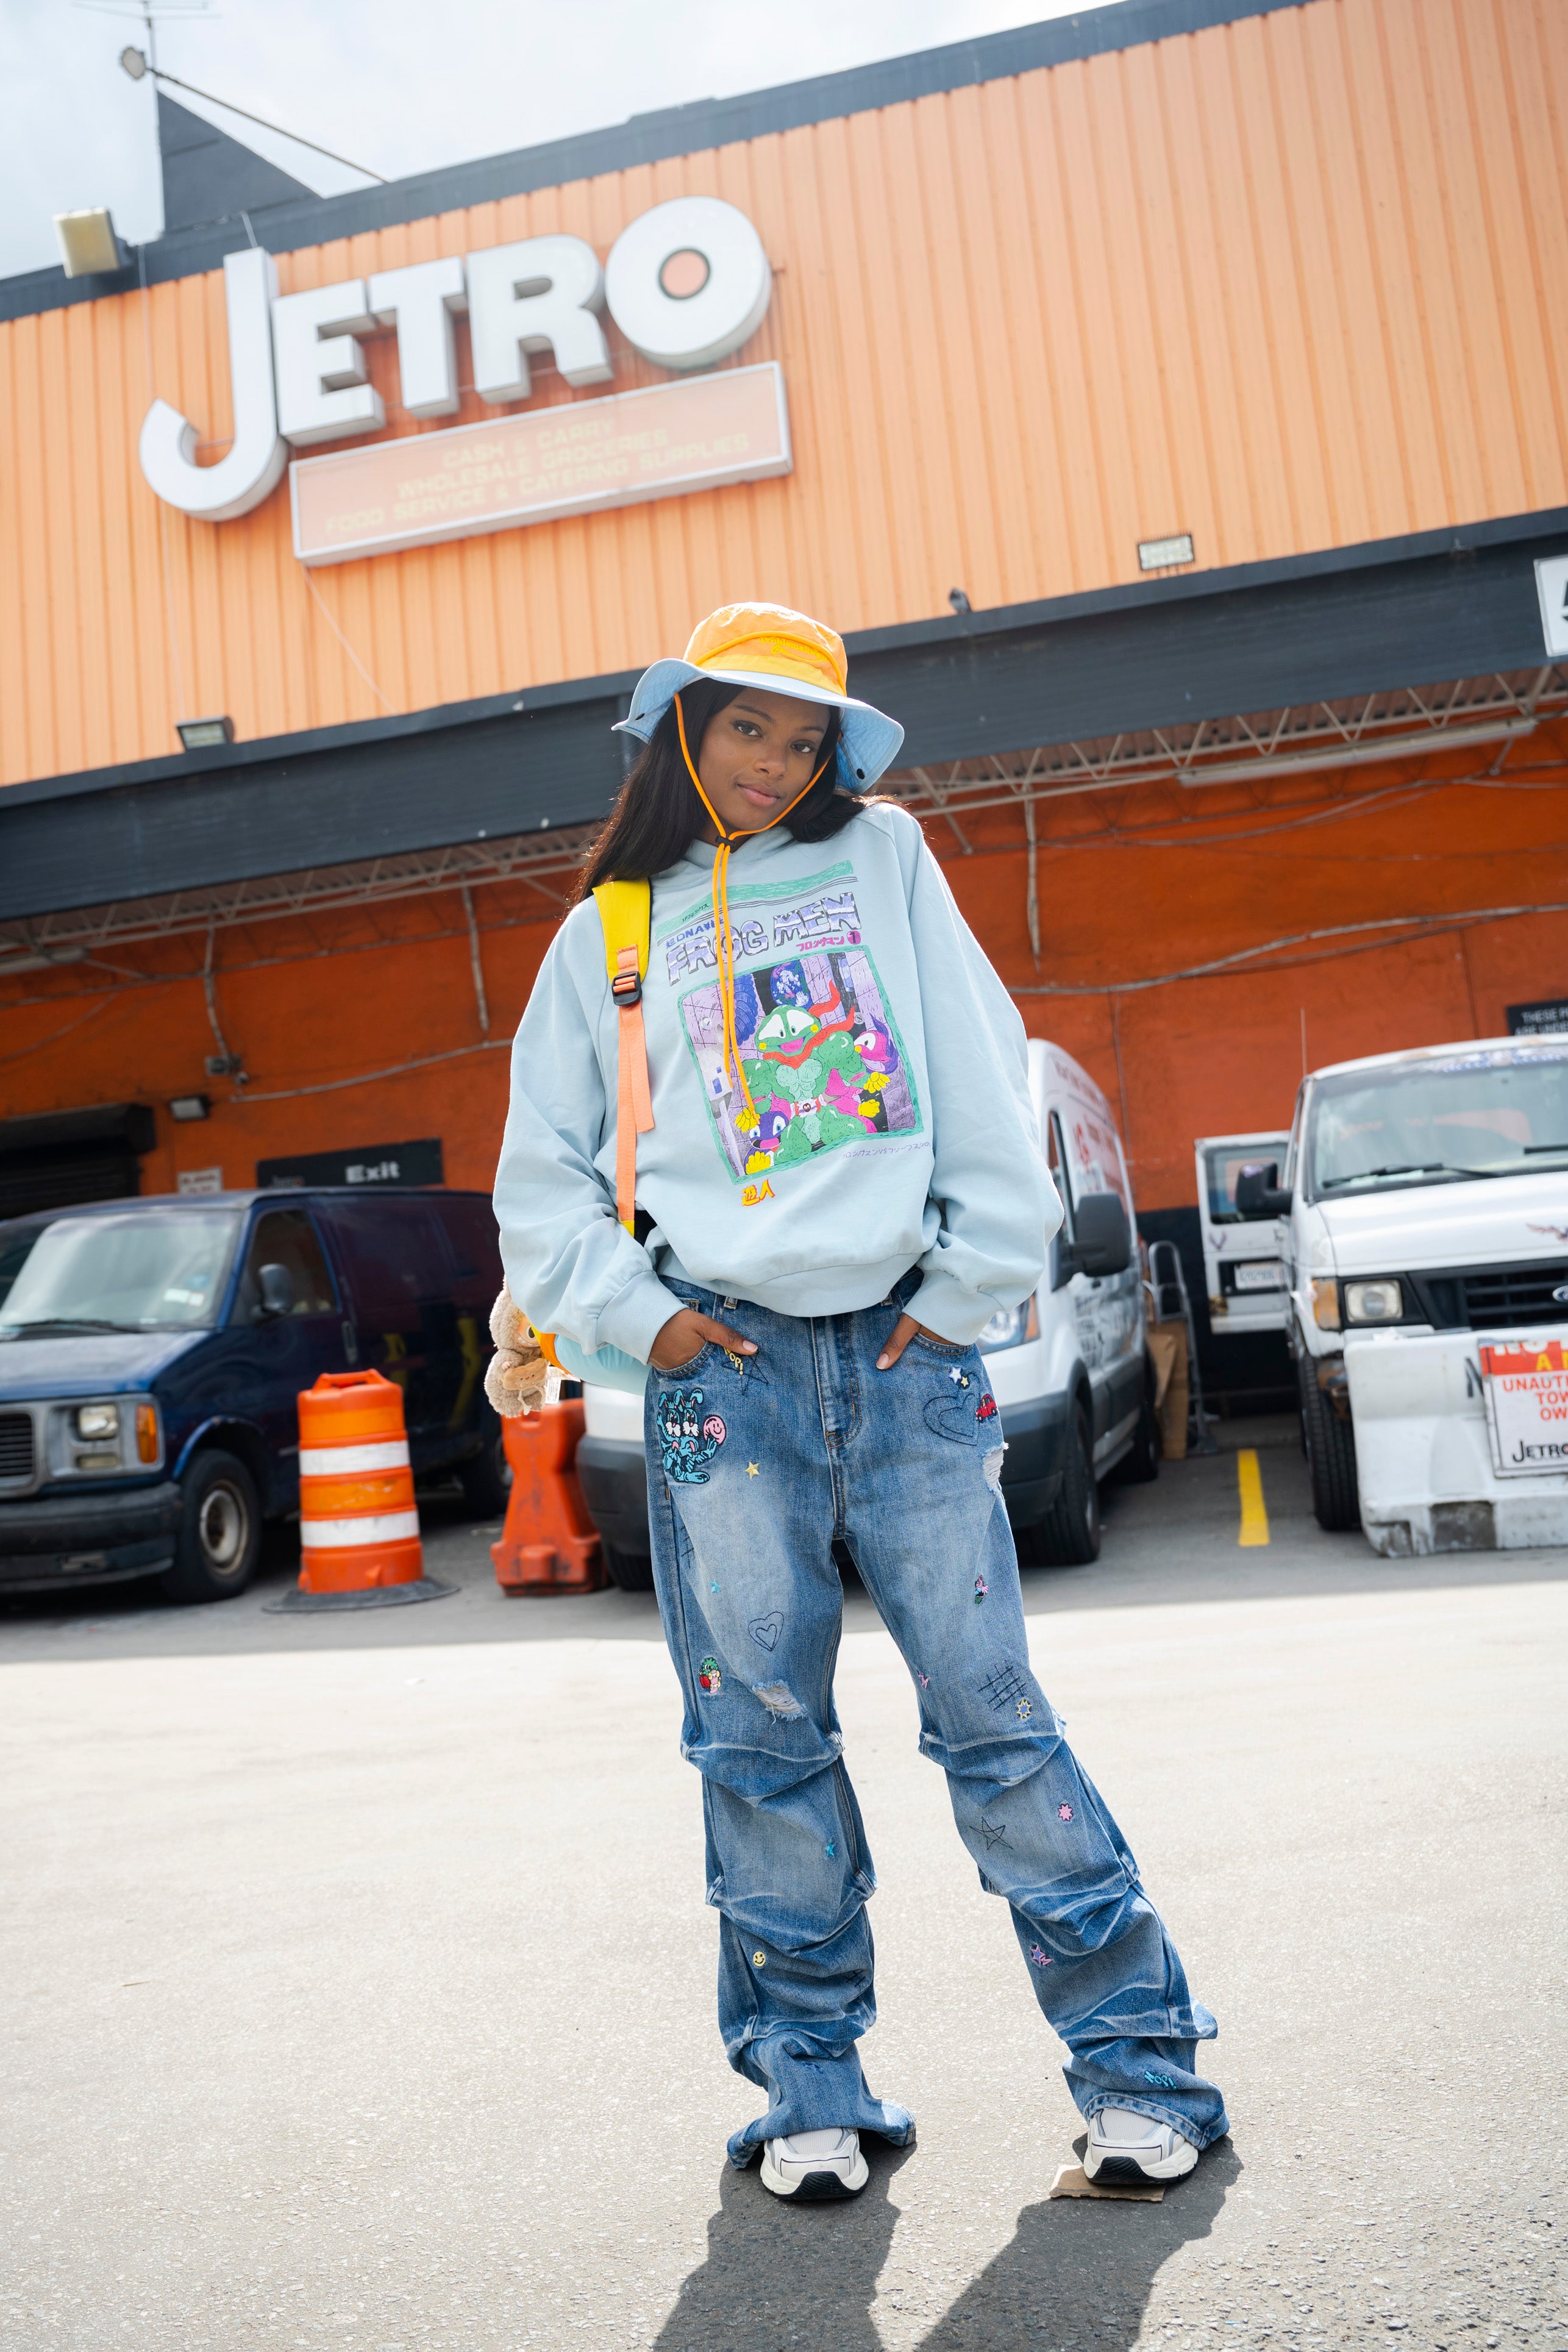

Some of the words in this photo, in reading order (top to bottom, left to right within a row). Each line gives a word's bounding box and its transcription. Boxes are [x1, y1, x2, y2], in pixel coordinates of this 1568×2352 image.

[139, 196, 772, 521] JETRO
[399, 456, 530, 497] WHOLESALE
[541, 428, 668, 469] GROCERIES
[443, 440, 505, 468] CASH
[515, 440, 527, 455] &
[538, 418, 614, 449] CARRY
[326, 507, 384, 533] FOOD
[394, 488, 485, 520] SERVICE
[519, 457, 629, 495] CATERING
[639, 433, 749, 471] SUPPLIES
[666, 921, 769, 986] FROG
[773, 892, 861, 947] MEN
[346, 1161, 401, 1183] Exit
[1503, 1375, 1568, 1392] UNAUT
